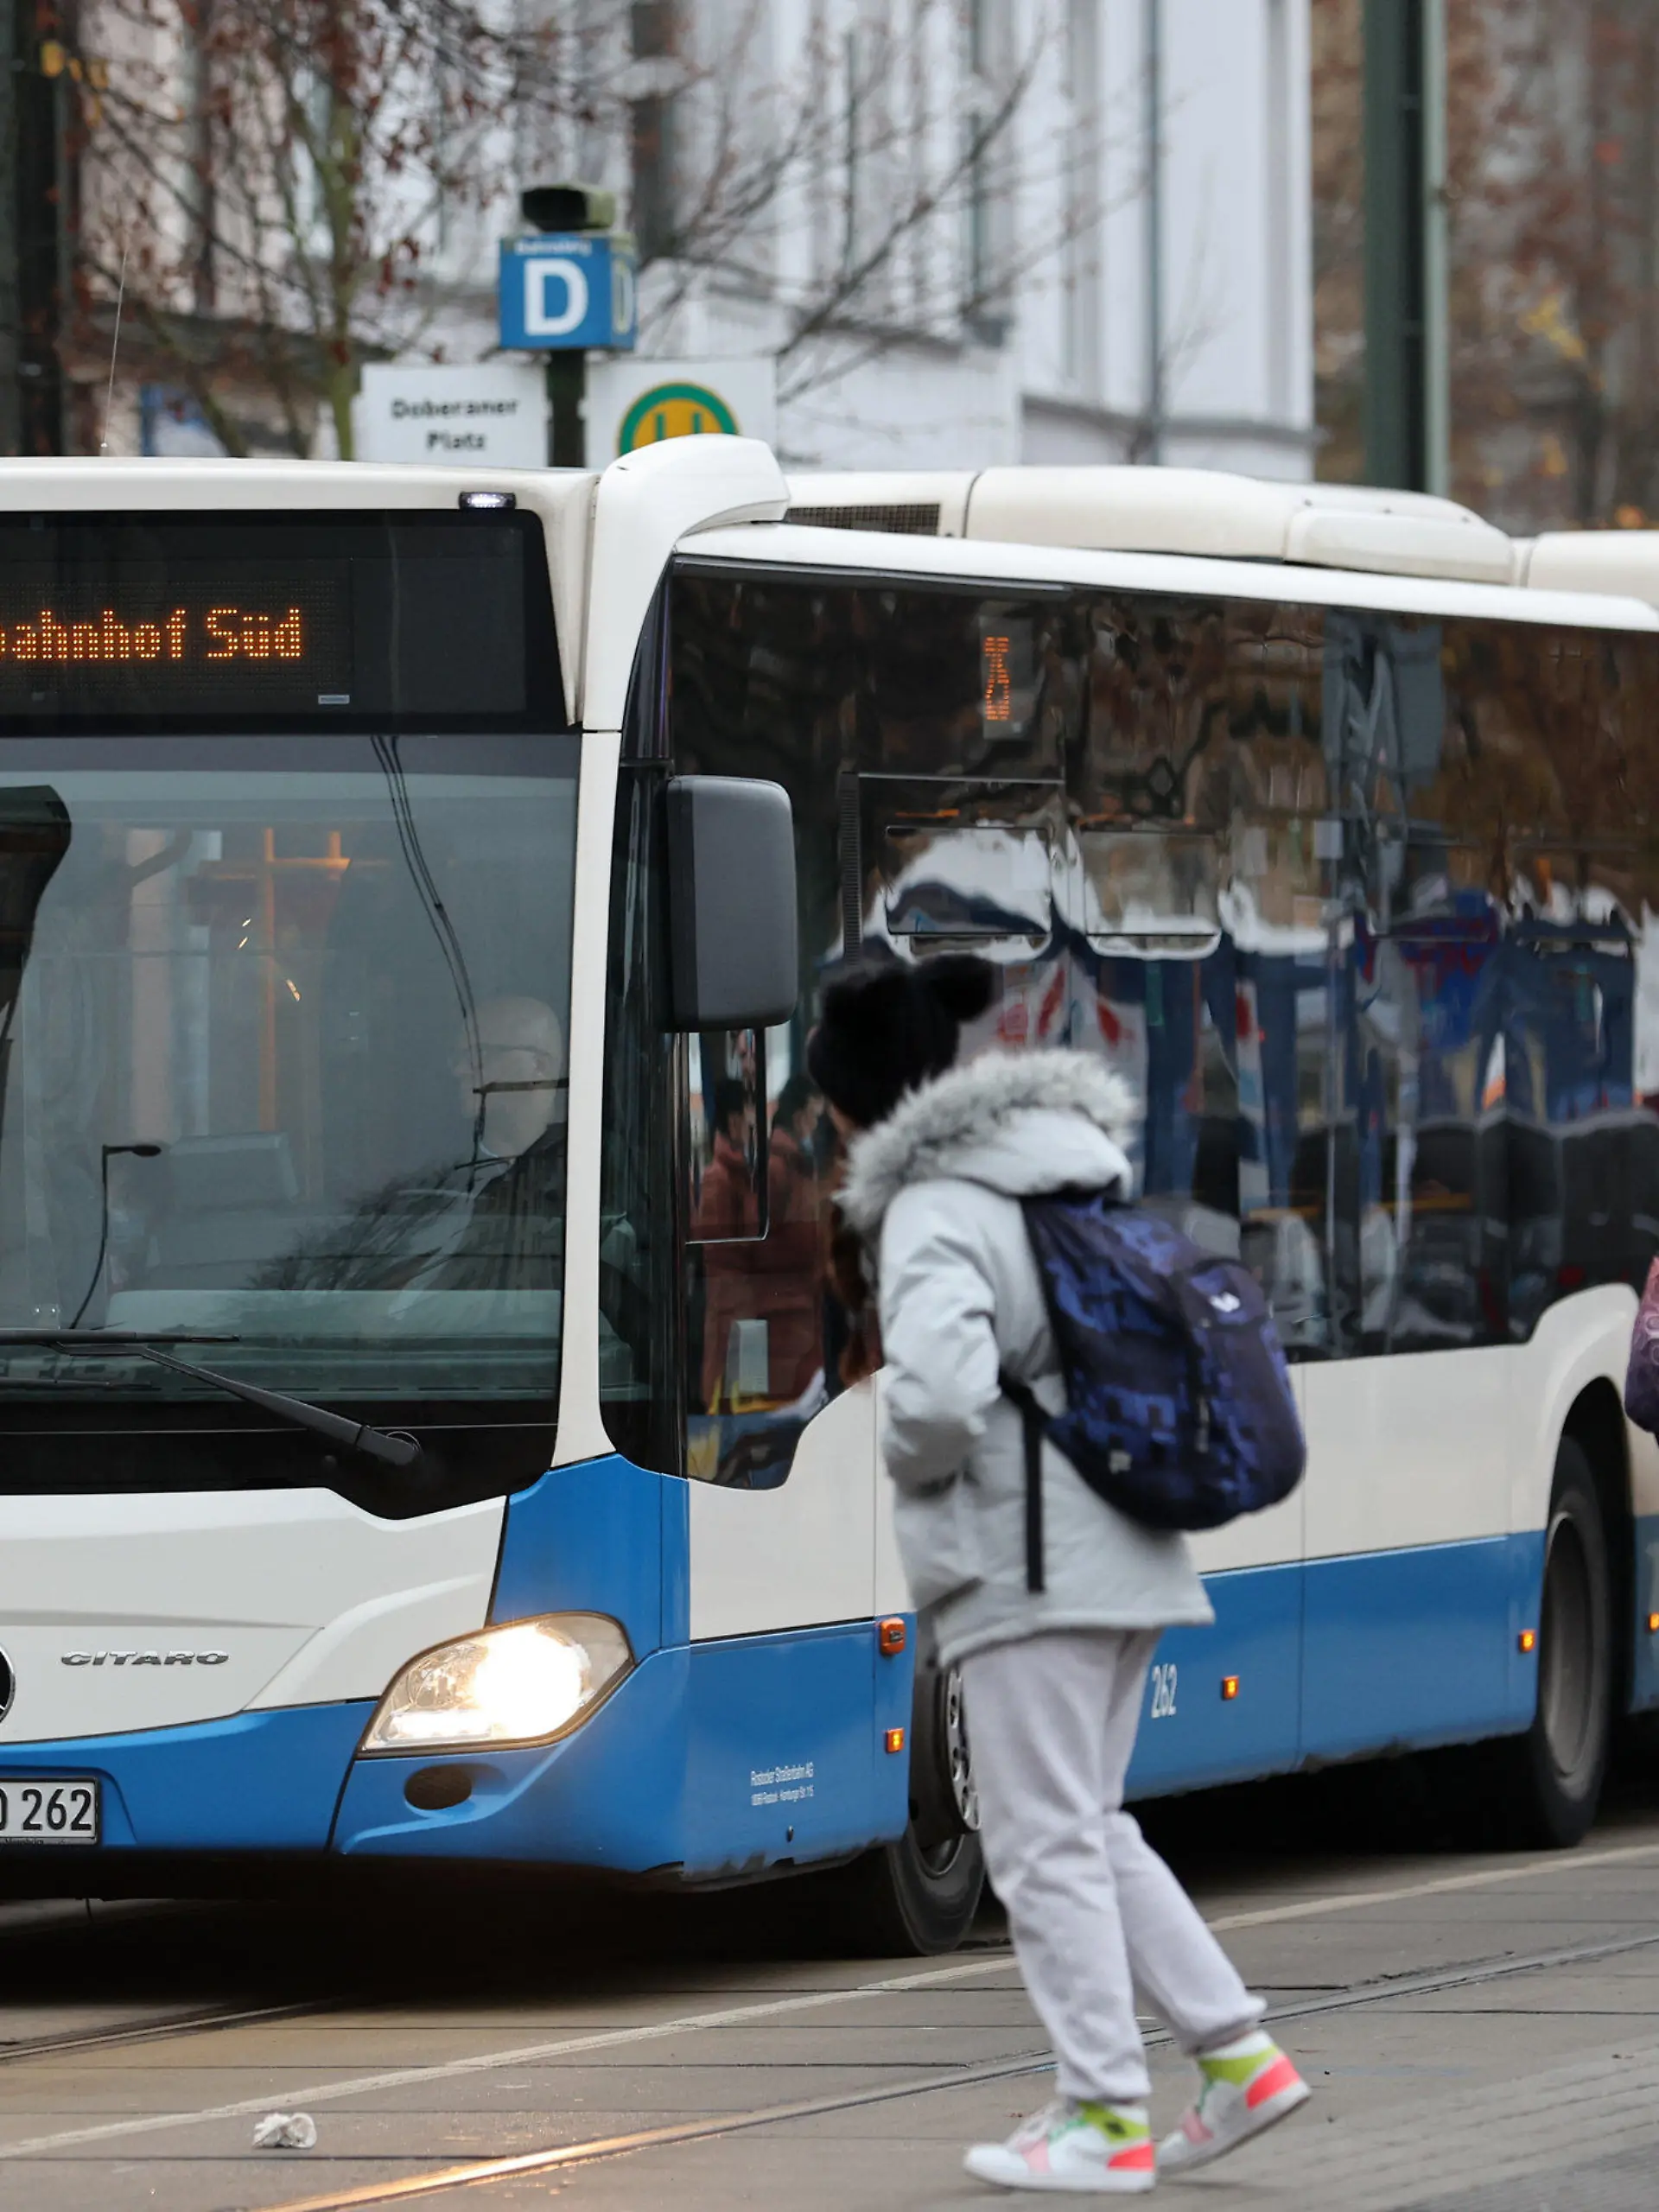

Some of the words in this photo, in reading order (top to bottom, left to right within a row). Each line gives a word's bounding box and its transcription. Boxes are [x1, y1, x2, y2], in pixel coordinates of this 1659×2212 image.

[524, 258, 588, 336] D
[391, 397, 518, 416] Doberaner
[428, 434, 486, 451] Platz
[0, 609, 186, 659] ahnhof
[207, 608, 302, 658] Süd
[60, 1649, 230, 1666] CITARO
[1152, 1663, 1178, 1719] 262
[22, 1788, 92, 1831] 262
